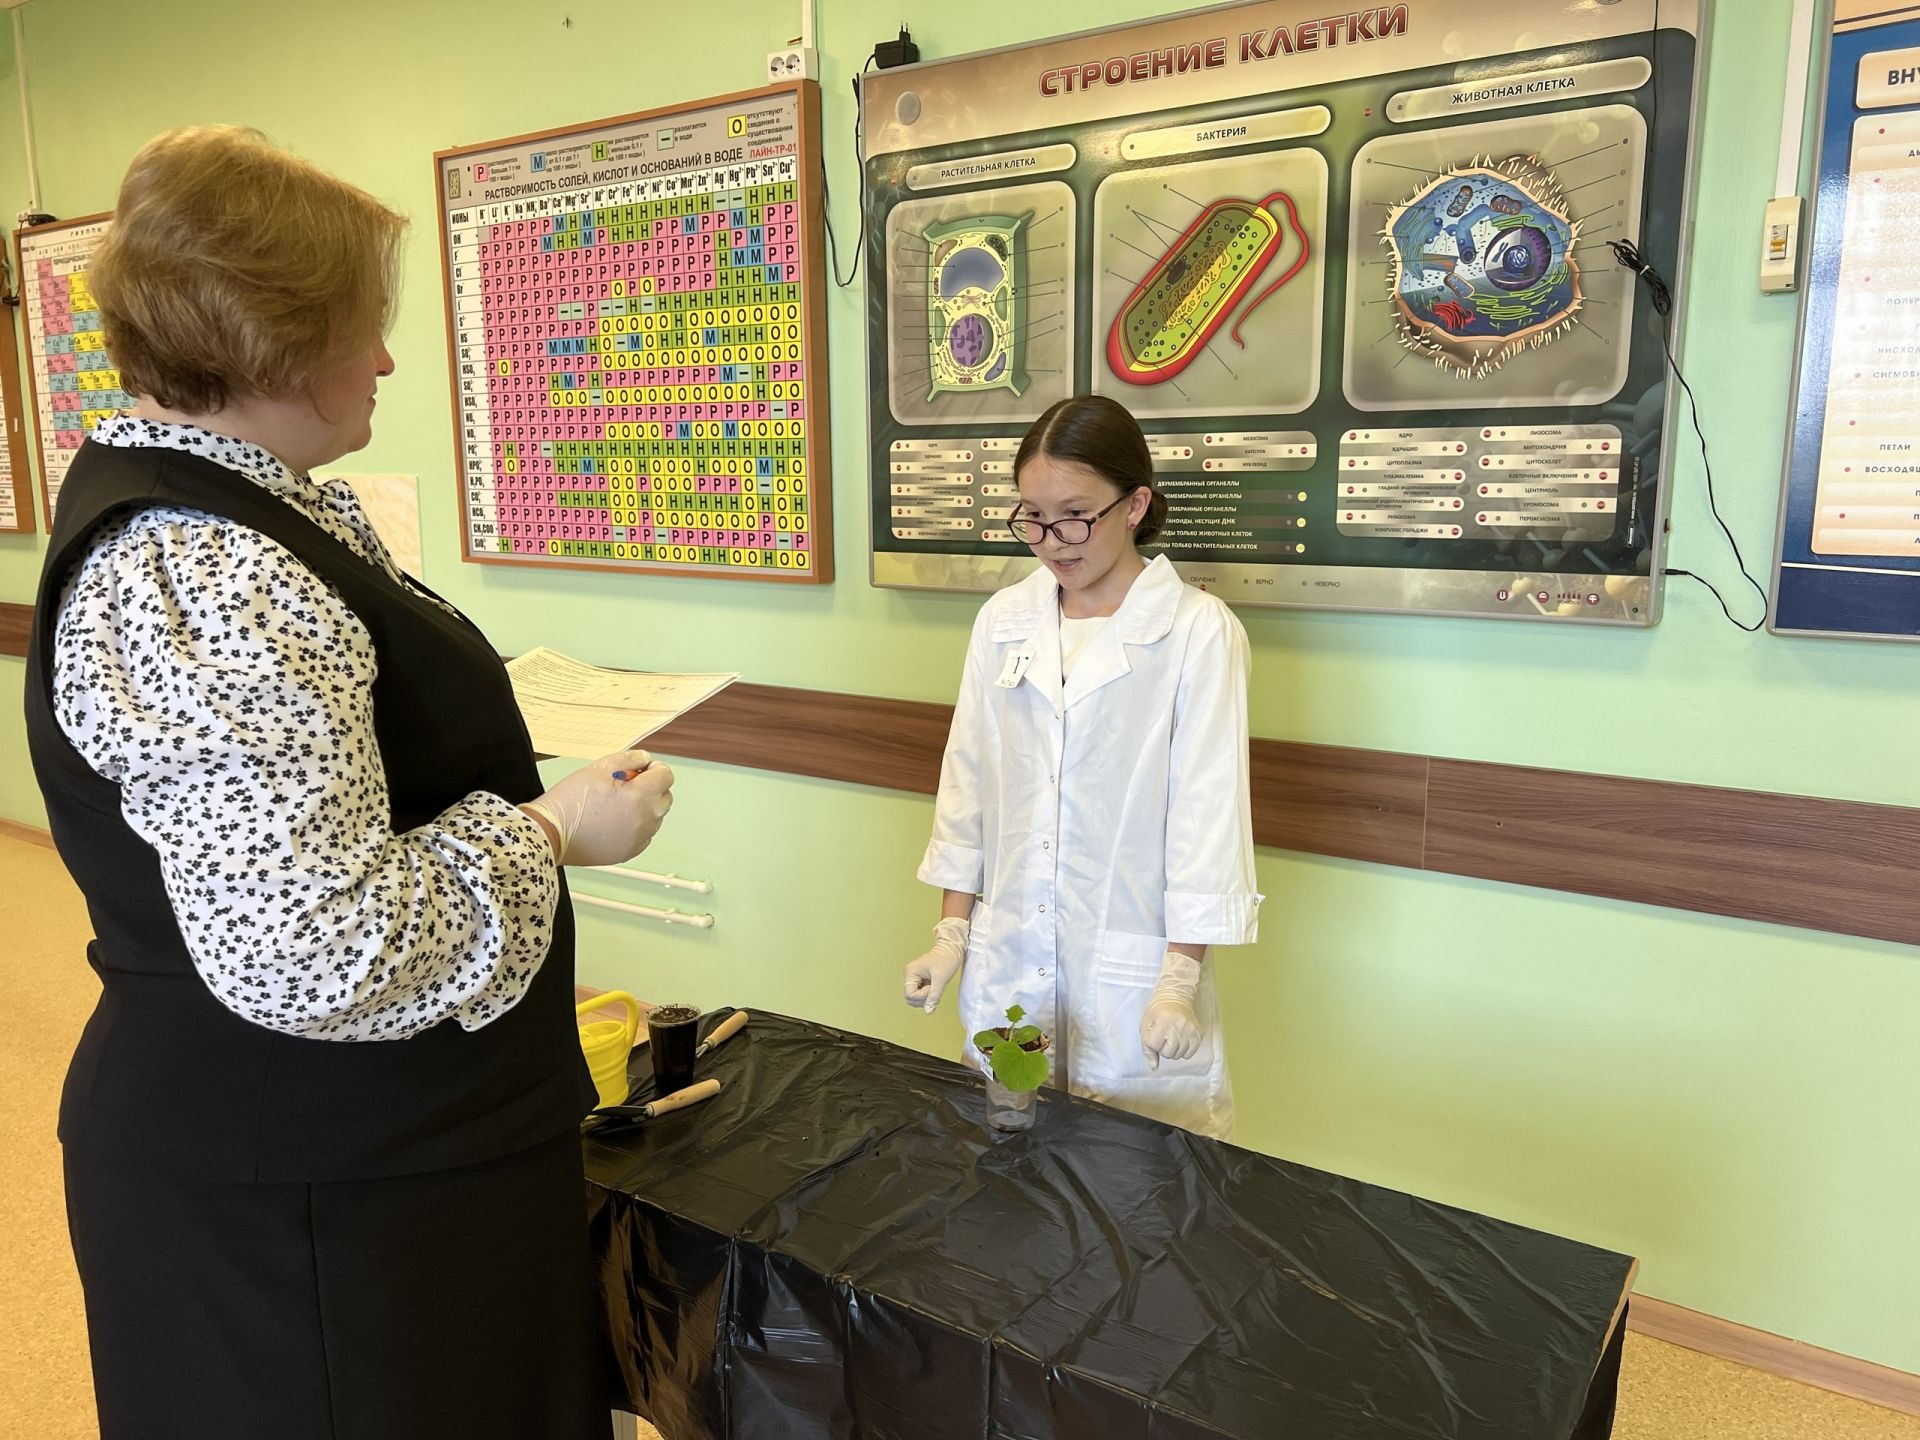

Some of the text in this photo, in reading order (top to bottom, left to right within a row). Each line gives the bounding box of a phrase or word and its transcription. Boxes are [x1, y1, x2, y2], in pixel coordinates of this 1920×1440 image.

[1039, 4, 1409, 97] СТРОЕНИЕ КЛЕТКИ
[1452, 77, 1575, 104] ЖИВОТНАЯ КЛЕТКА
[1196, 126, 1246, 141] БАКТЕРИЯ
[595, 144, 604, 159] Н
[533, 155, 543, 170] М
[941, 157, 1036, 178] РАСТИТЕЛЬНАЯ КЛЕТКА
[477, 166, 484, 180] Р
[485, 148, 743, 200] РАСТВОРИМОСТЬ СОЛЕЙ, КИСЛОТ И ОСНОВАНИЙ В ВОДЕ
